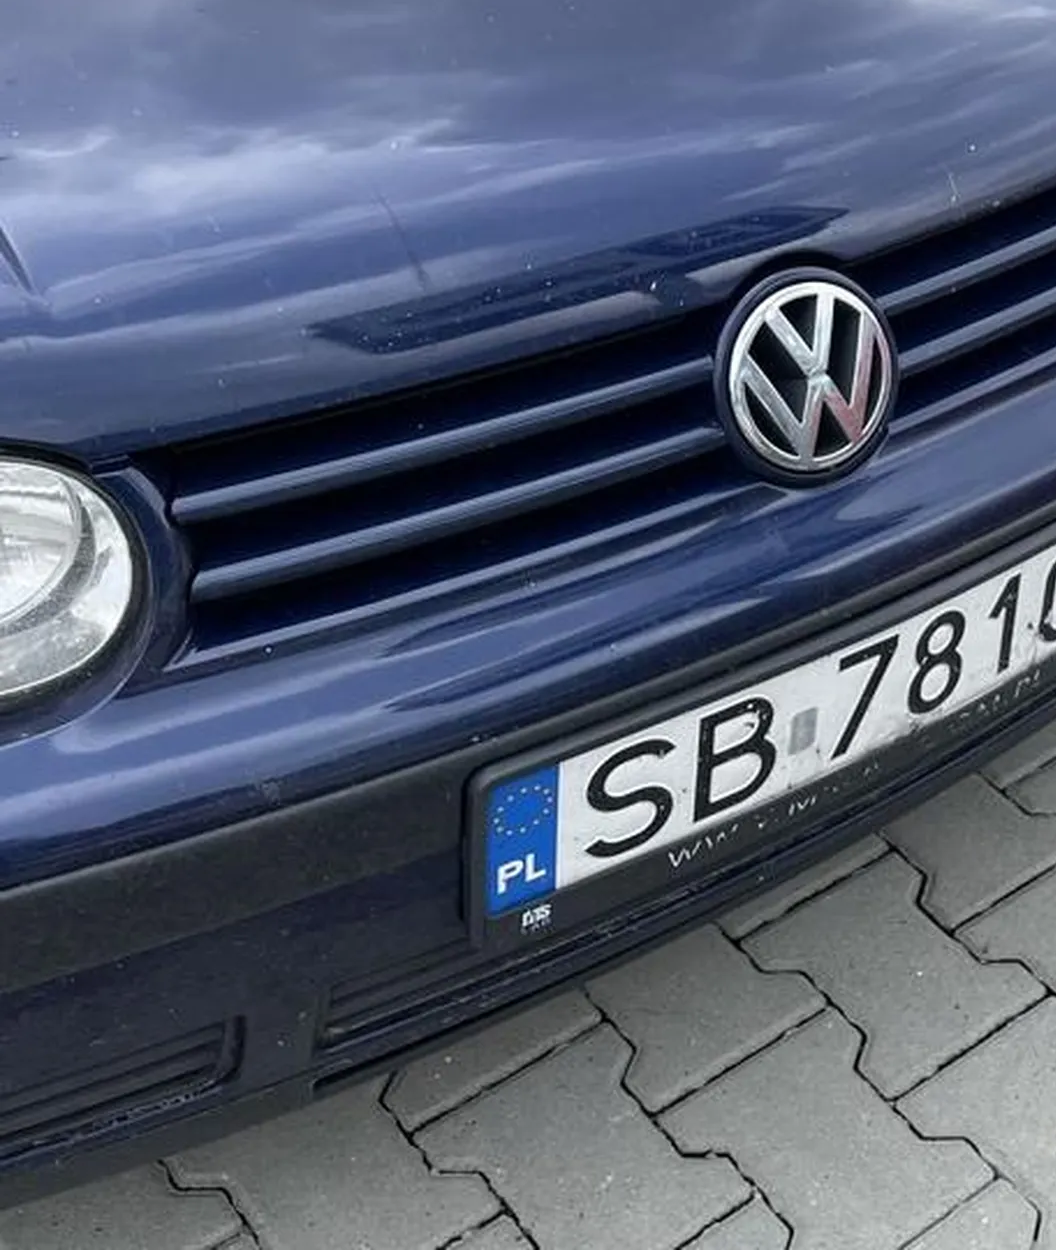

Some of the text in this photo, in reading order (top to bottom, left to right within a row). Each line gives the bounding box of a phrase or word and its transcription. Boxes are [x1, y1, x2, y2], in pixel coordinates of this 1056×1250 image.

[730, 282, 892, 471] VW
[584, 691, 778, 857] SB
[496, 852, 547, 896] PL
